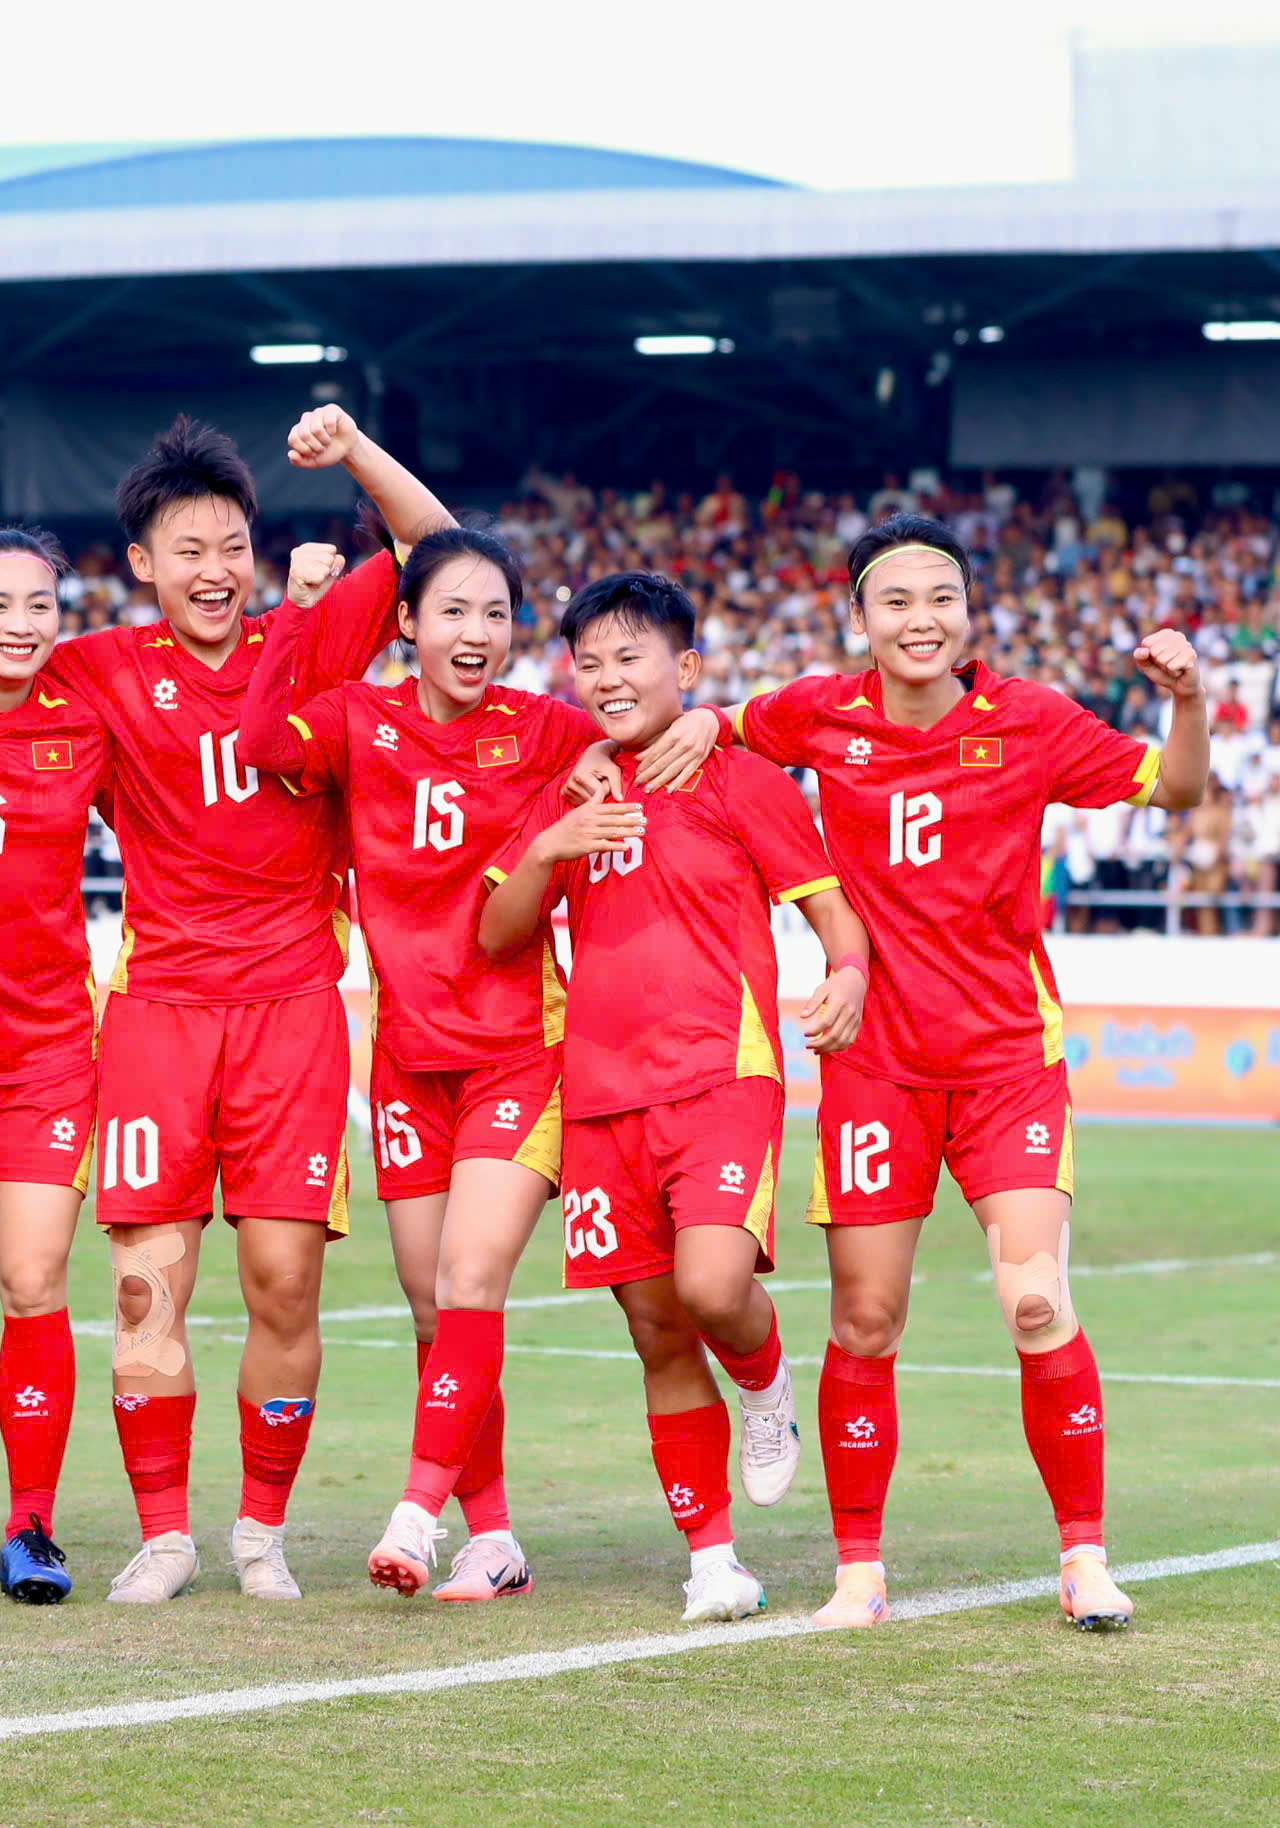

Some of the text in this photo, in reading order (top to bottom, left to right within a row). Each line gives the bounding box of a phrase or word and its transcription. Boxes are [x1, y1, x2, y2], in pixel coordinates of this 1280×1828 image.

[200, 729, 259, 808] 10
[413, 778, 466, 853] 15
[889, 791, 943, 868] 12
[103, 1115, 159, 1191] 10
[377, 1100, 423, 1169] 15
[840, 1120, 891, 1195] 12
[563, 1186, 619, 1260] 23
